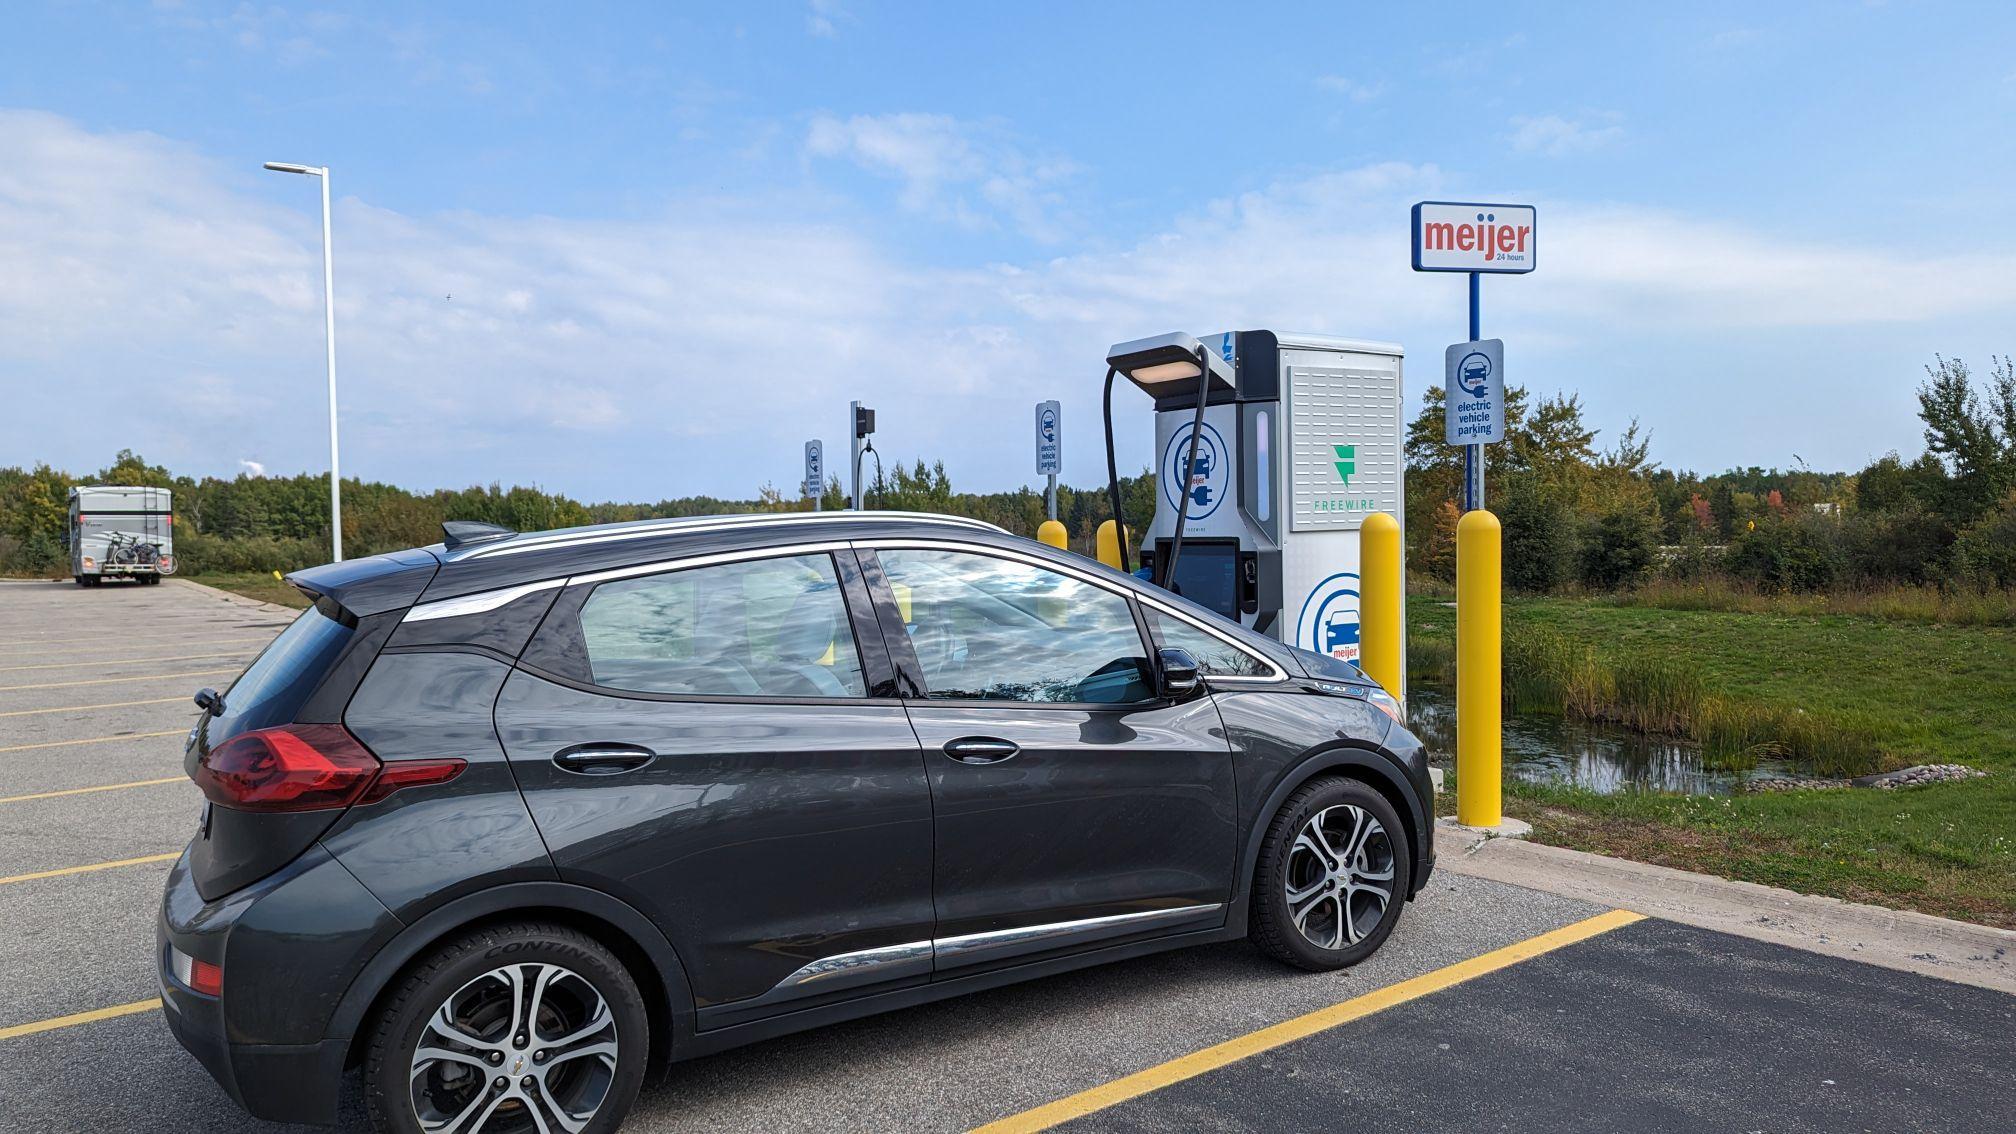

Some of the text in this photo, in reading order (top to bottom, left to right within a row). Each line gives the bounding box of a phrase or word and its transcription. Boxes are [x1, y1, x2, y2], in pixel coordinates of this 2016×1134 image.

[1425, 213, 1530, 261] meijer
[1496, 253, 1525, 261] 24 hours
[1457, 399, 1492, 413] electric
[1458, 411, 1490, 424] vehicle
[1458, 423, 1493, 438] parking
[1190, 475, 1205, 486] eijer
[1314, 499, 1375, 511] FREEWIRE
[1333, 646, 1358, 660] meijer
